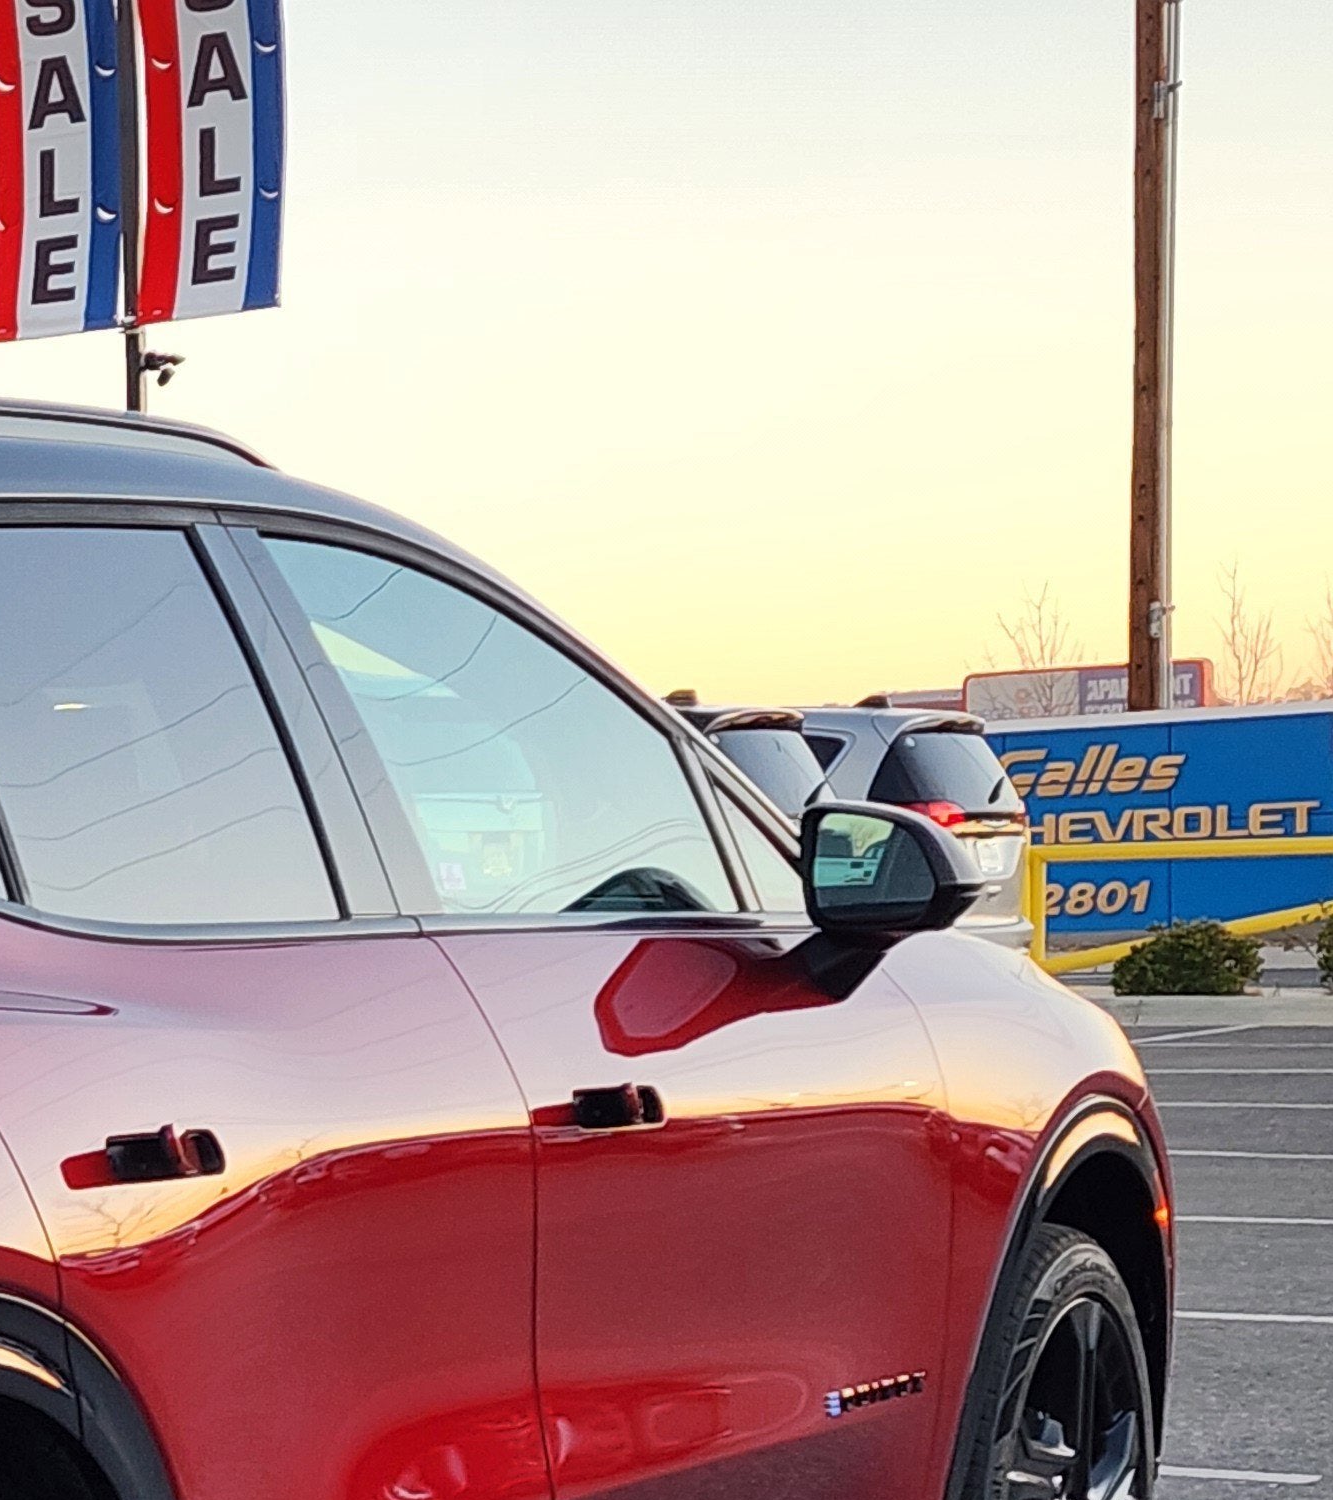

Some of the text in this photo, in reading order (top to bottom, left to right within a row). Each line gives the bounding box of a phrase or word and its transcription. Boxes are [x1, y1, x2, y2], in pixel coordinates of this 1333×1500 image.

[187, 0, 248, 286] ALE
[1000, 744, 1186, 797] Galles
[1030, 800, 1320, 844] HEVROLET
[1045, 880, 1150, 916] 2801
